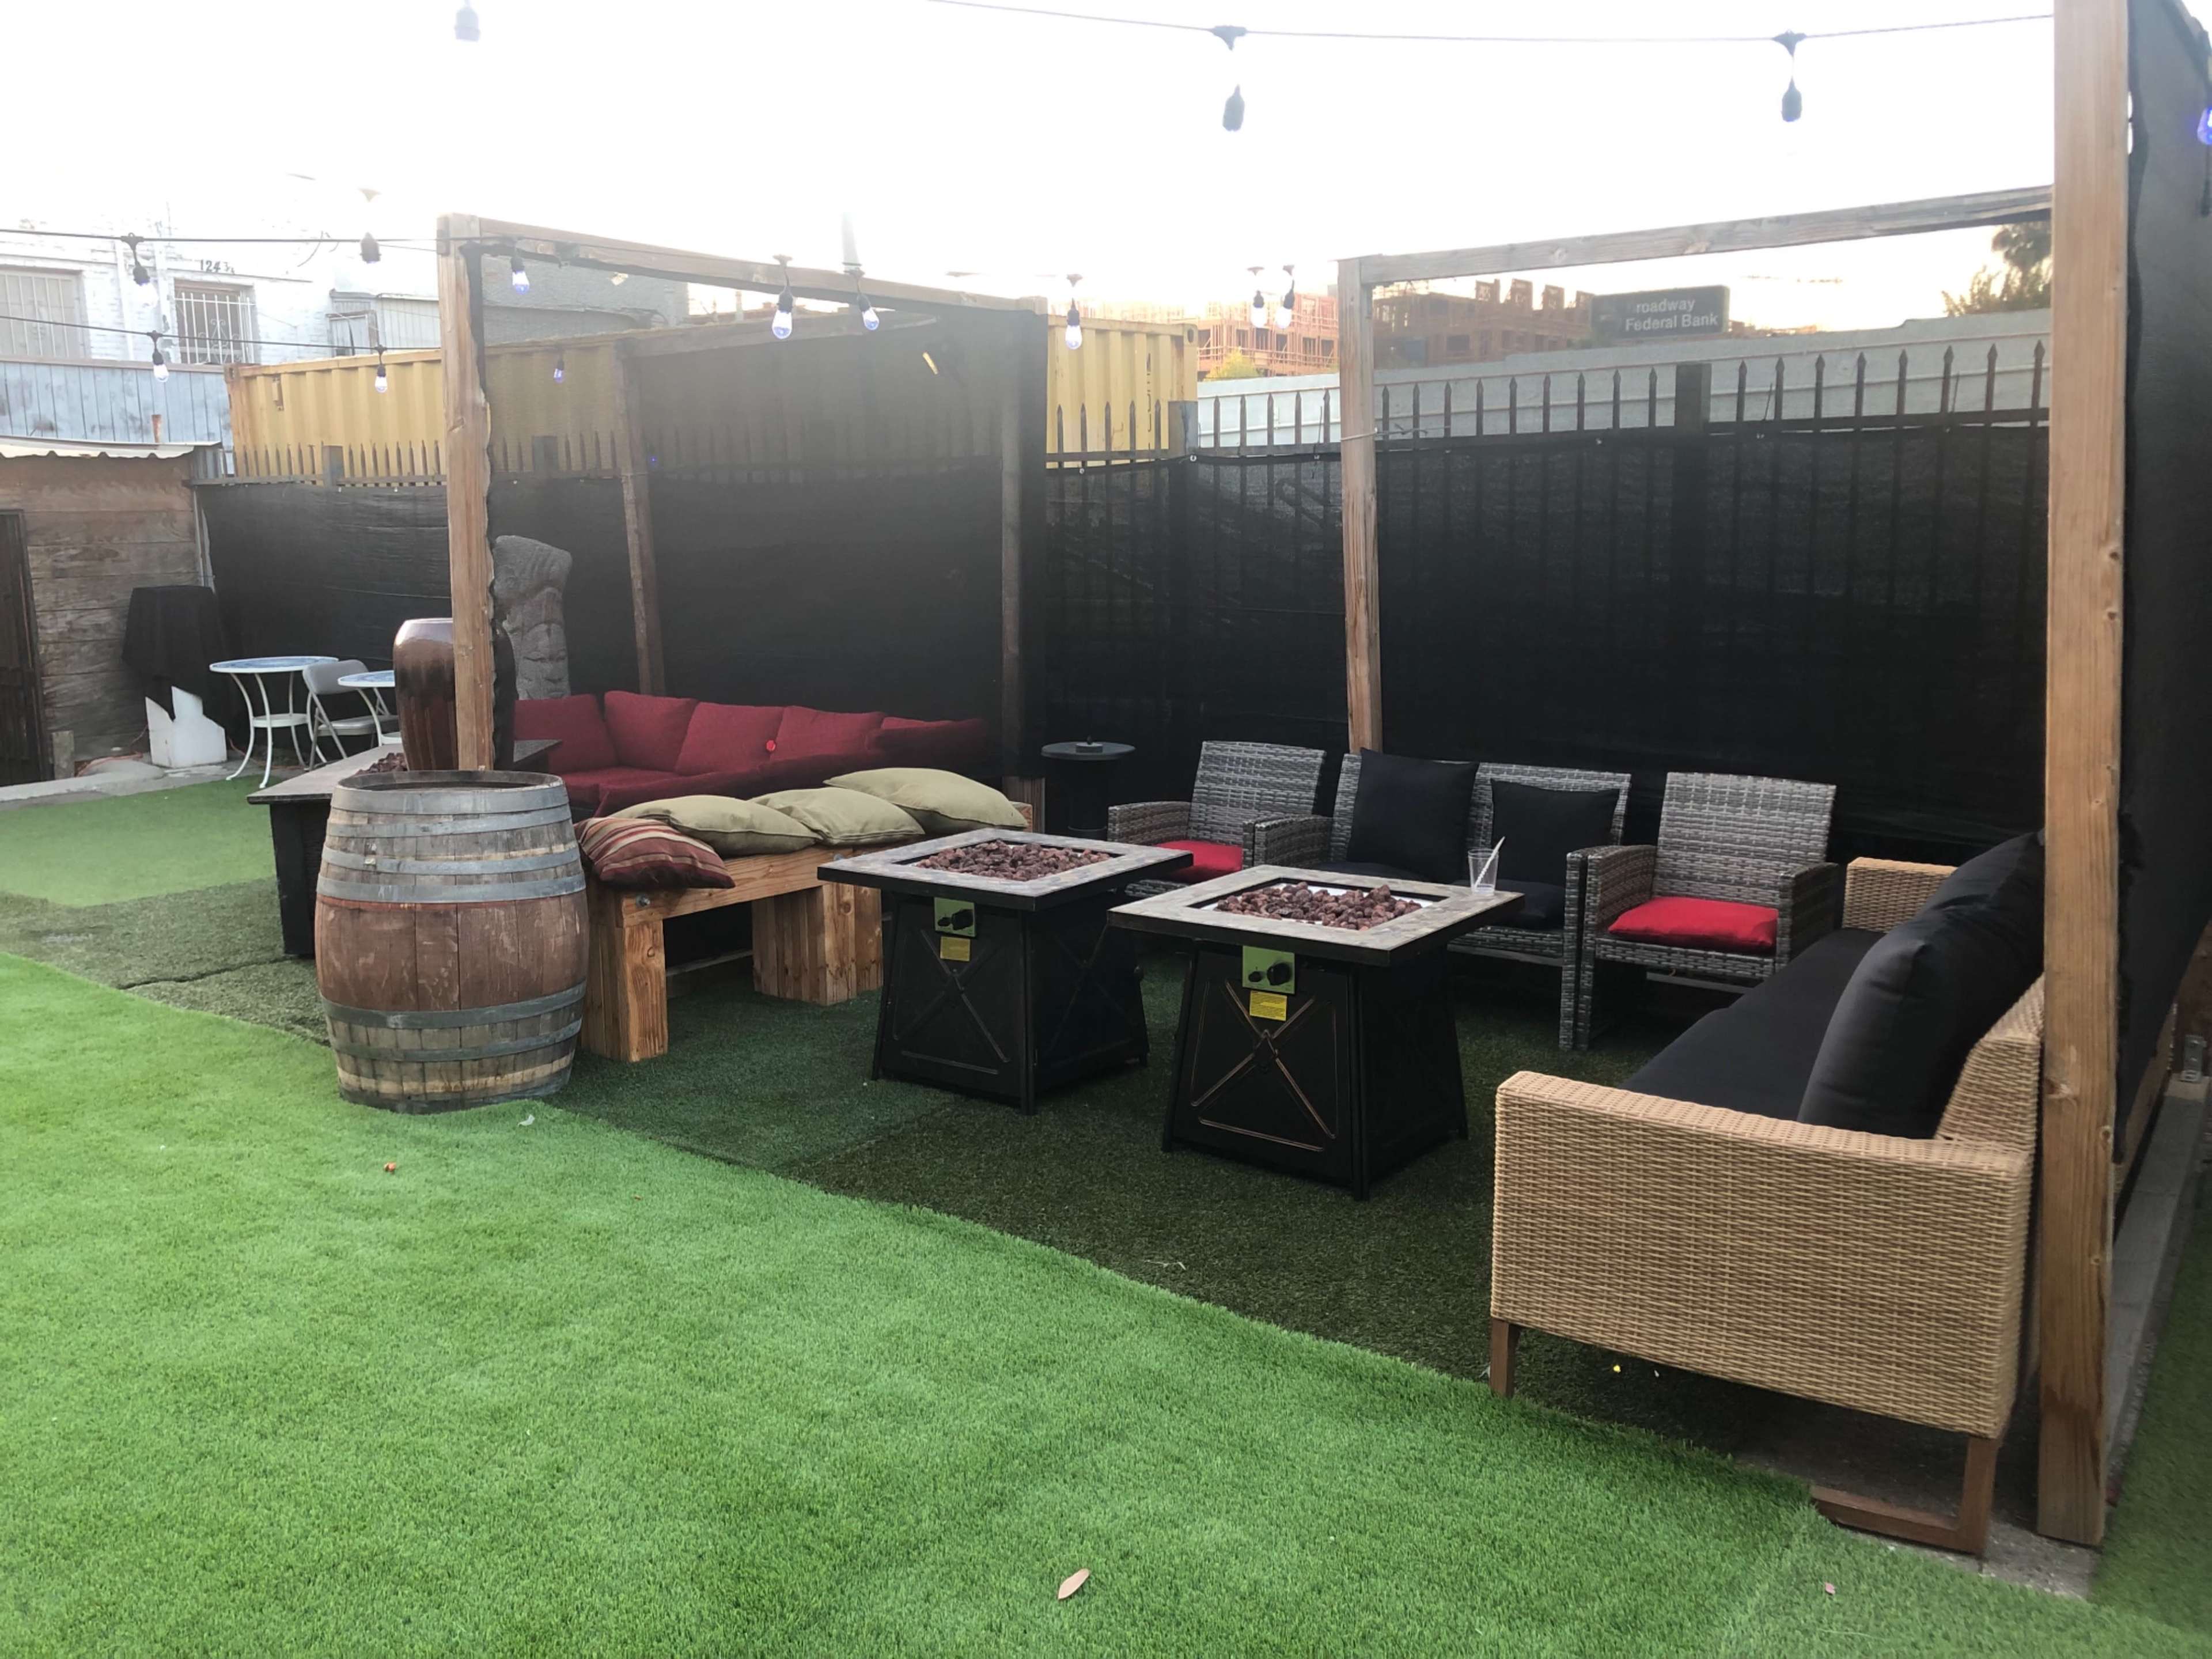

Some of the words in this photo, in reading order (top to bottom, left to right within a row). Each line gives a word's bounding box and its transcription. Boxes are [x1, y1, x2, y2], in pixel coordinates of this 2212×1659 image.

[200, 260, 221, 272] 124
[1625, 315, 1677, 331] Federal
[1681, 312, 1719, 328] Bank
